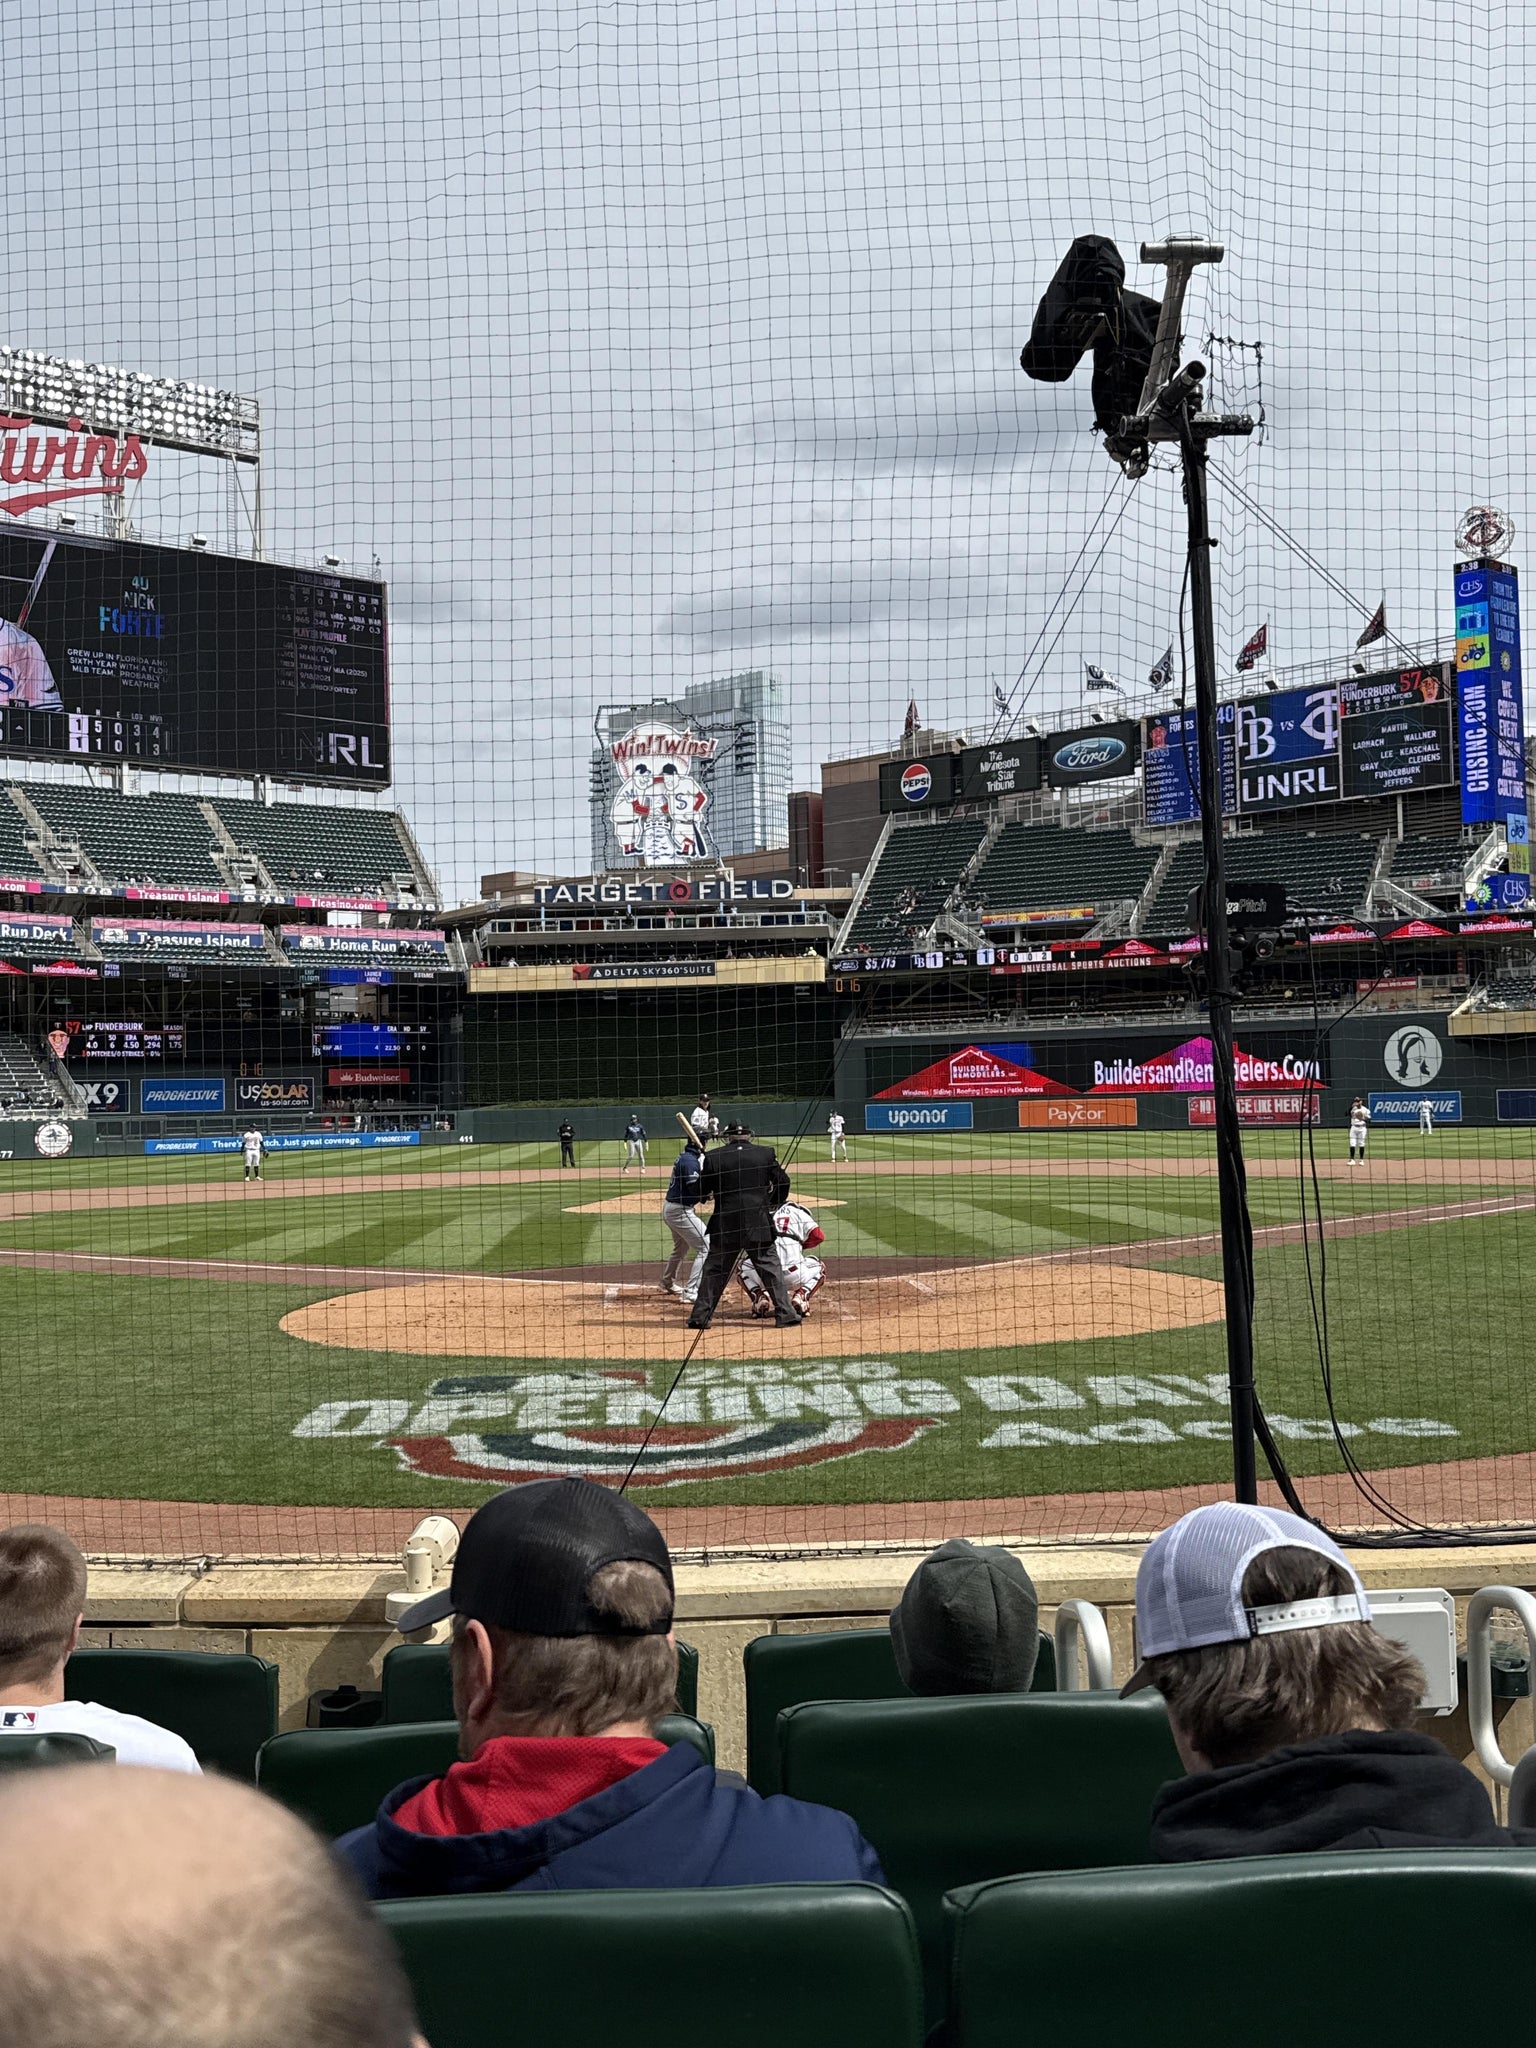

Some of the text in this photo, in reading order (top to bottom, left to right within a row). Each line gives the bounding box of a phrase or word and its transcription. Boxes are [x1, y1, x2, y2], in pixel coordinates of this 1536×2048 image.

[1460, 579, 1481, 592] CHS
[67, 648, 90, 658] GREW
[92, 651, 104, 660] UP
[106, 652, 114, 660] IN
[70, 657, 94, 666] SIXTH
[96, 659, 117, 669] YEAR
[72, 665, 90, 674] MLB
[122, 679, 160, 689] WEATHER
[1400, 670, 1422, 692] 57
[1341, 684, 1397, 702] FUNDERBURK
[76, 718, 160, 739] 1 5 0 3 4
[1382, 723, 1408, 734] MARTIN
[1404, 730, 1436, 742] WALLNER
[1464, 684, 1490, 793] CHSINC.COM
[76, 736, 160, 756] 1 1 0 1 3
[612, 734, 716, 760] Win! Twins!
[1353, 738, 1384, 750] LARNACH
[1400, 743, 1440, 756] KEASCHALL
[988, 750, 1003, 762] The
[1068, 742, 1111, 767] Ford
[1380, 750, 1394, 759] LEE
[1408, 753, 1440, 764] CLEMENS
[980, 757, 1020, 773] Minnesota
[1360, 762, 1379, 772] GRAY
[998, 768, 1016, 781] Star
[1375, 766, 1420, 780] FUNDERBURK
[902, 778, 930, 788] PEPSI
[986, 780, 1016, 793] Tribune
[1242, 766, 1338, 802] UNRL
[1383, 776, 1413, 788] JEFFERS
[536, 879, 794, 903] TARGET FIELD
[1505, 880, 1524, 897] CHS
[138, 890, 220, 902] Treasure Island
[2, 924, 28, 939] Run
[206, 934, 250, 948] Island
[330, 938, 396, 952] Home Run
[932, 954, 938, 966] 1
[984, 950, 988, 963] 1
[604, 968, 640, 976] DELTA
[684, 966, 712, 974] SUITE
[1021, 957, 1150, 973] UNIVERSAL SPORTS AUCTIONS
[95, 1022, 144, 1031] FUNDERBURK
[86, 1041, 98, 1049] 4.0
[124, 1041, 140, 1049] 4.50
[144, 1041, 160, 1049] .294
[169, 1041, 182, 1049] 1.75
[122, 1050, 144, 1058] STRIKES
[953, 1064, 990, 1072] BUILDERS
[1094, 1054, 1320, 1085] BuildersandRemdelers.Com
[355, 1073, 400, 1082] Budweiser
[103, 1083, 119, 1104] 9
[146, 1090, 220, 1102] PROGRESSIVE
[261, 1084, 308, 1099] SOLAR
[902, 1088, 930, 1096] Windows
[933, 1088, 952, 1096] Siding
[956, 1088, 980, 1096] Roofing
[1007, 1086, 1024, 1094] Patio
[1254, 1099, 1272, 1113] LIKE
[1274, 1098, 1308, 1113] HERE
[888, 1109, 948, 1127] uponor
[1048, 1106, 1106, 1124] Paycor
[155, 1142, 200, 1150] PROGRESSIVE
[212, 1137, 362, 1148] There's Just great coverage.
[292, 1377, 962, 1438] OPENING
